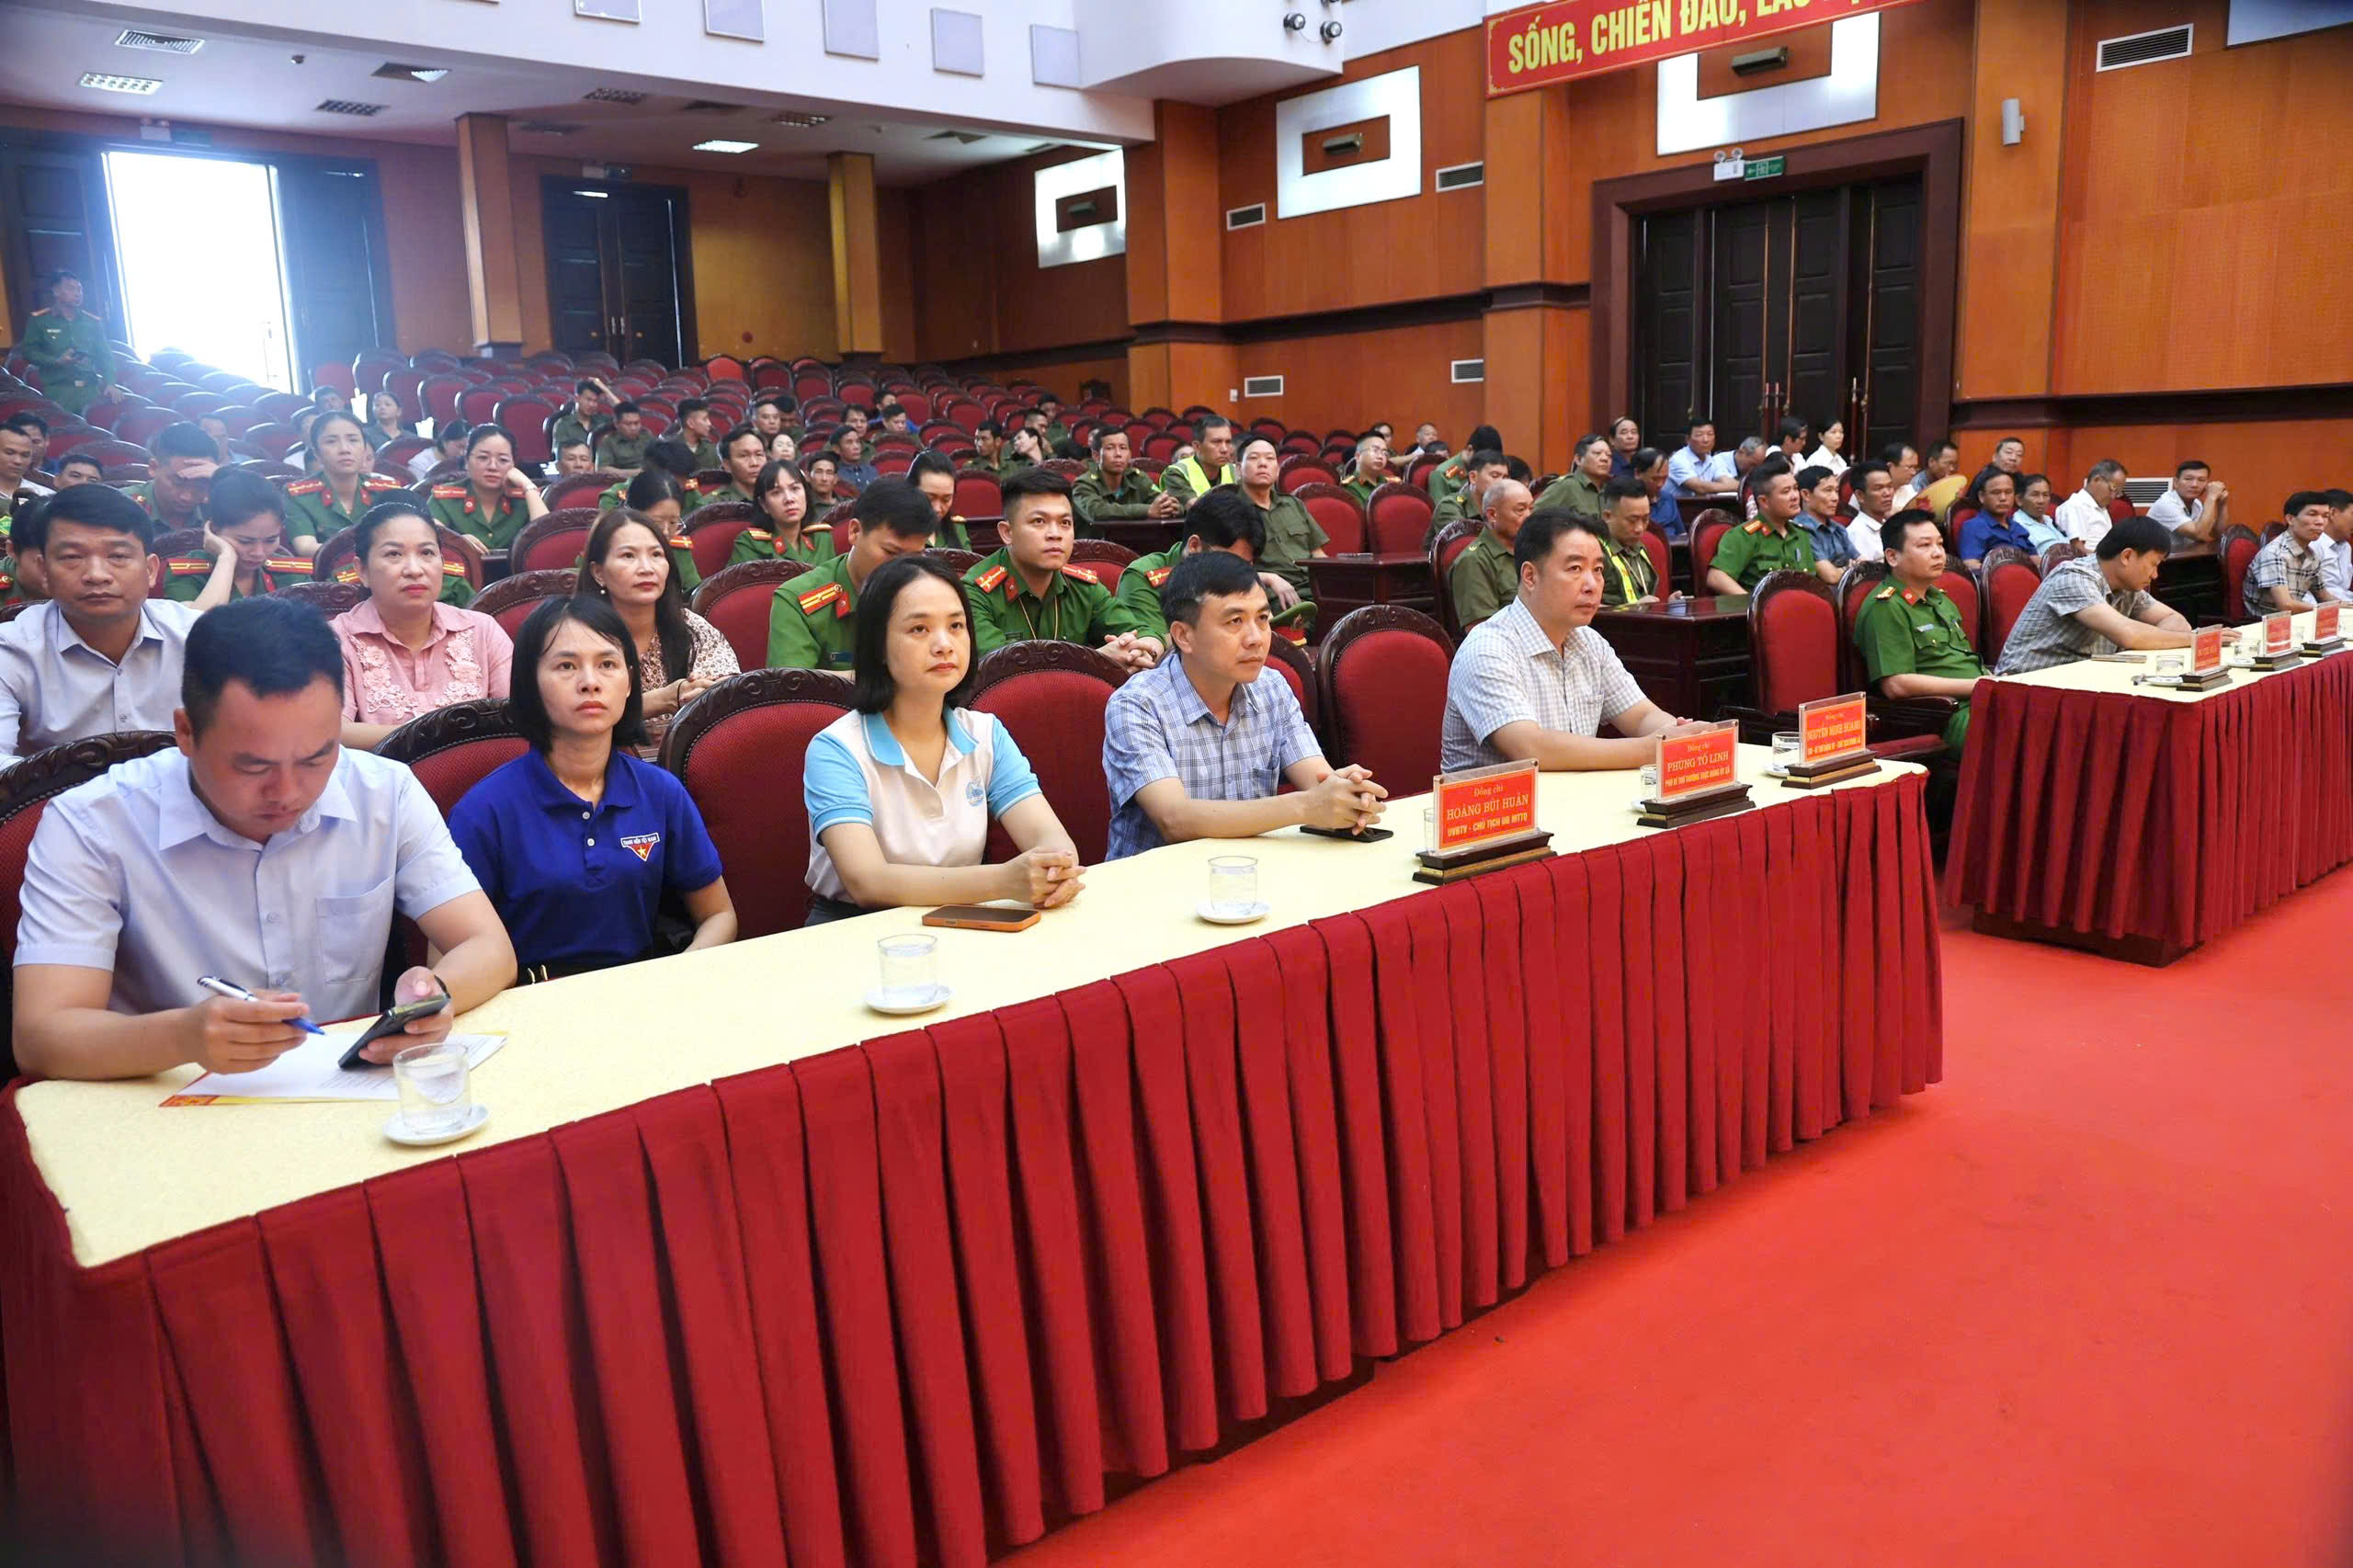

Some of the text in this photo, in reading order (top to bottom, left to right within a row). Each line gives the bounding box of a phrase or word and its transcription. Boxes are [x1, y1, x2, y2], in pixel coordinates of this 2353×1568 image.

[1508, 15, 1583, 74] SỐNG,
[1710, 750, 1729, 763] LINH
[1447, 803, 1481, 820] HOÀNG
[1483, 797, 1500, 813] BÙI
